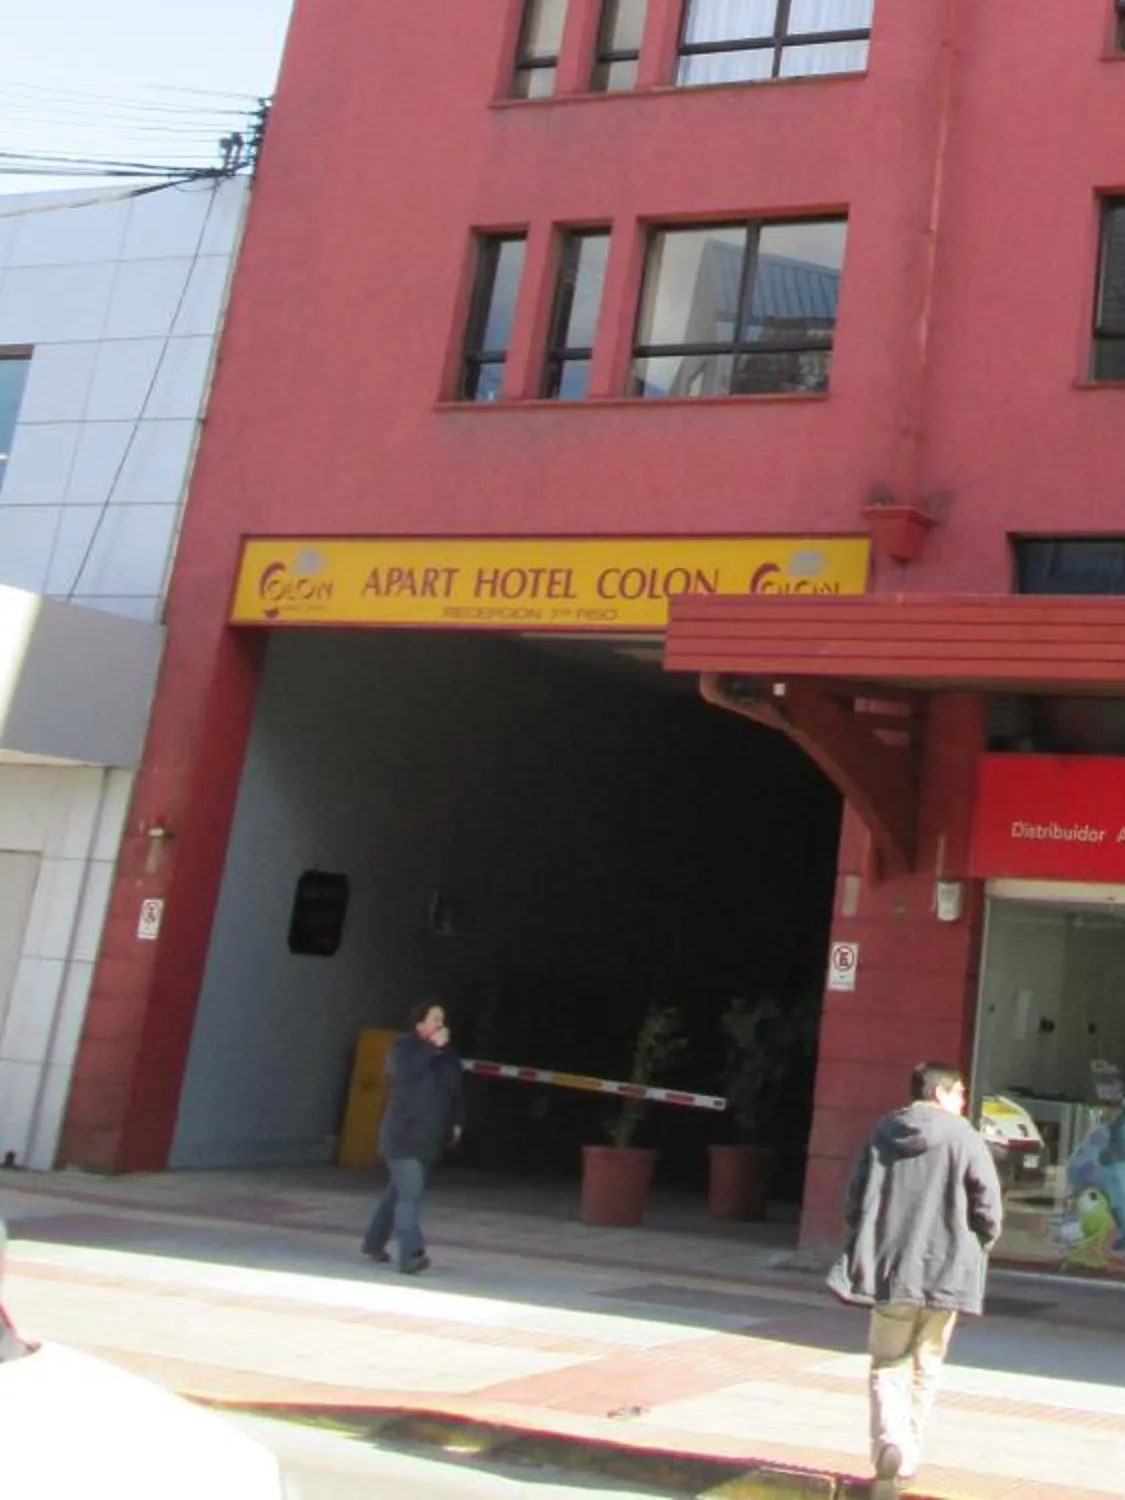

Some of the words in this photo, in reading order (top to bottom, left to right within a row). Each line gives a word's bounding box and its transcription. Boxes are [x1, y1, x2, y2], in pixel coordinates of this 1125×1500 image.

[361, 566, 459, 599] APART
[473, 567, 577, 600] HOTEL
[596, 567, 719, 599] COLON
[1011, 821, 1105, 843] Distribuidor
